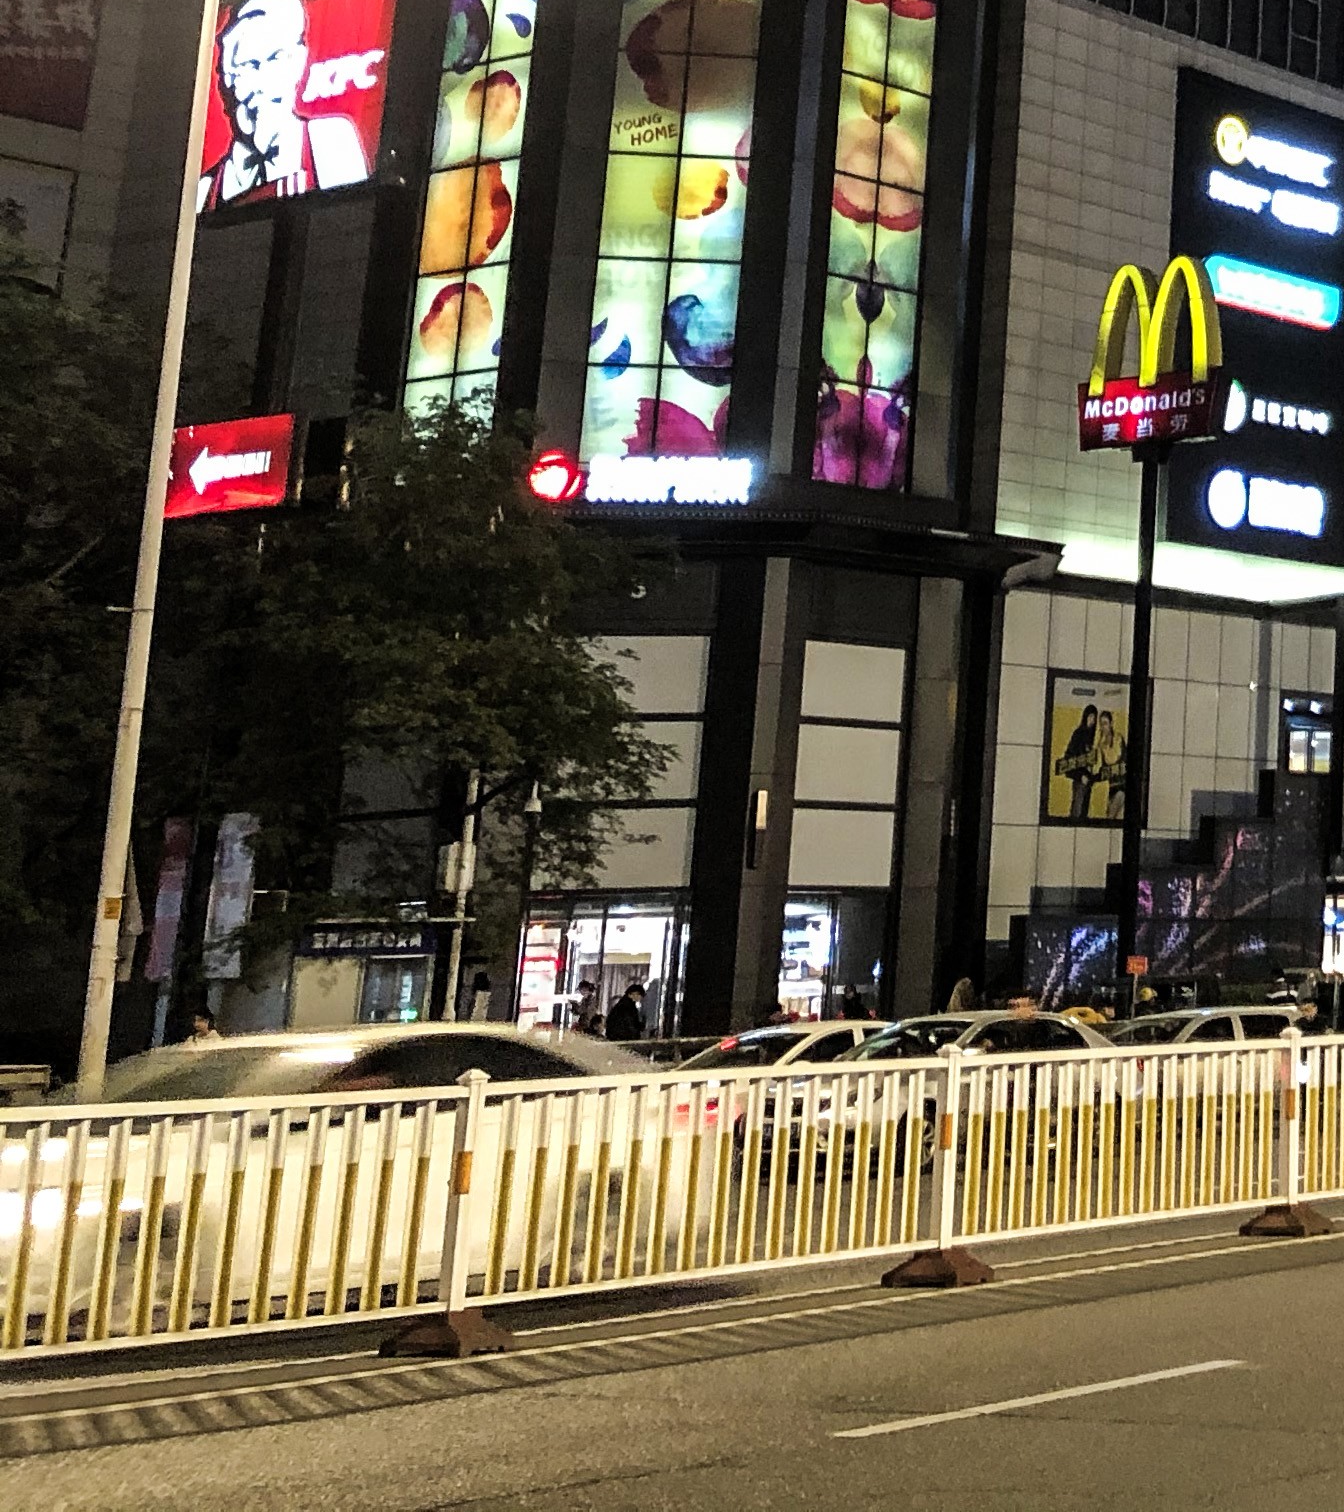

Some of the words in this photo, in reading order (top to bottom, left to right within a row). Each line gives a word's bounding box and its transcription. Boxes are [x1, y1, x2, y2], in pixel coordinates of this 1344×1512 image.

[301, 48, 385, 104] KFC
[613, 112, 662, 135] YOUNG
[630, 122, 678, 147] HOME
[1084, 387, 1206, 420] McDonald's
